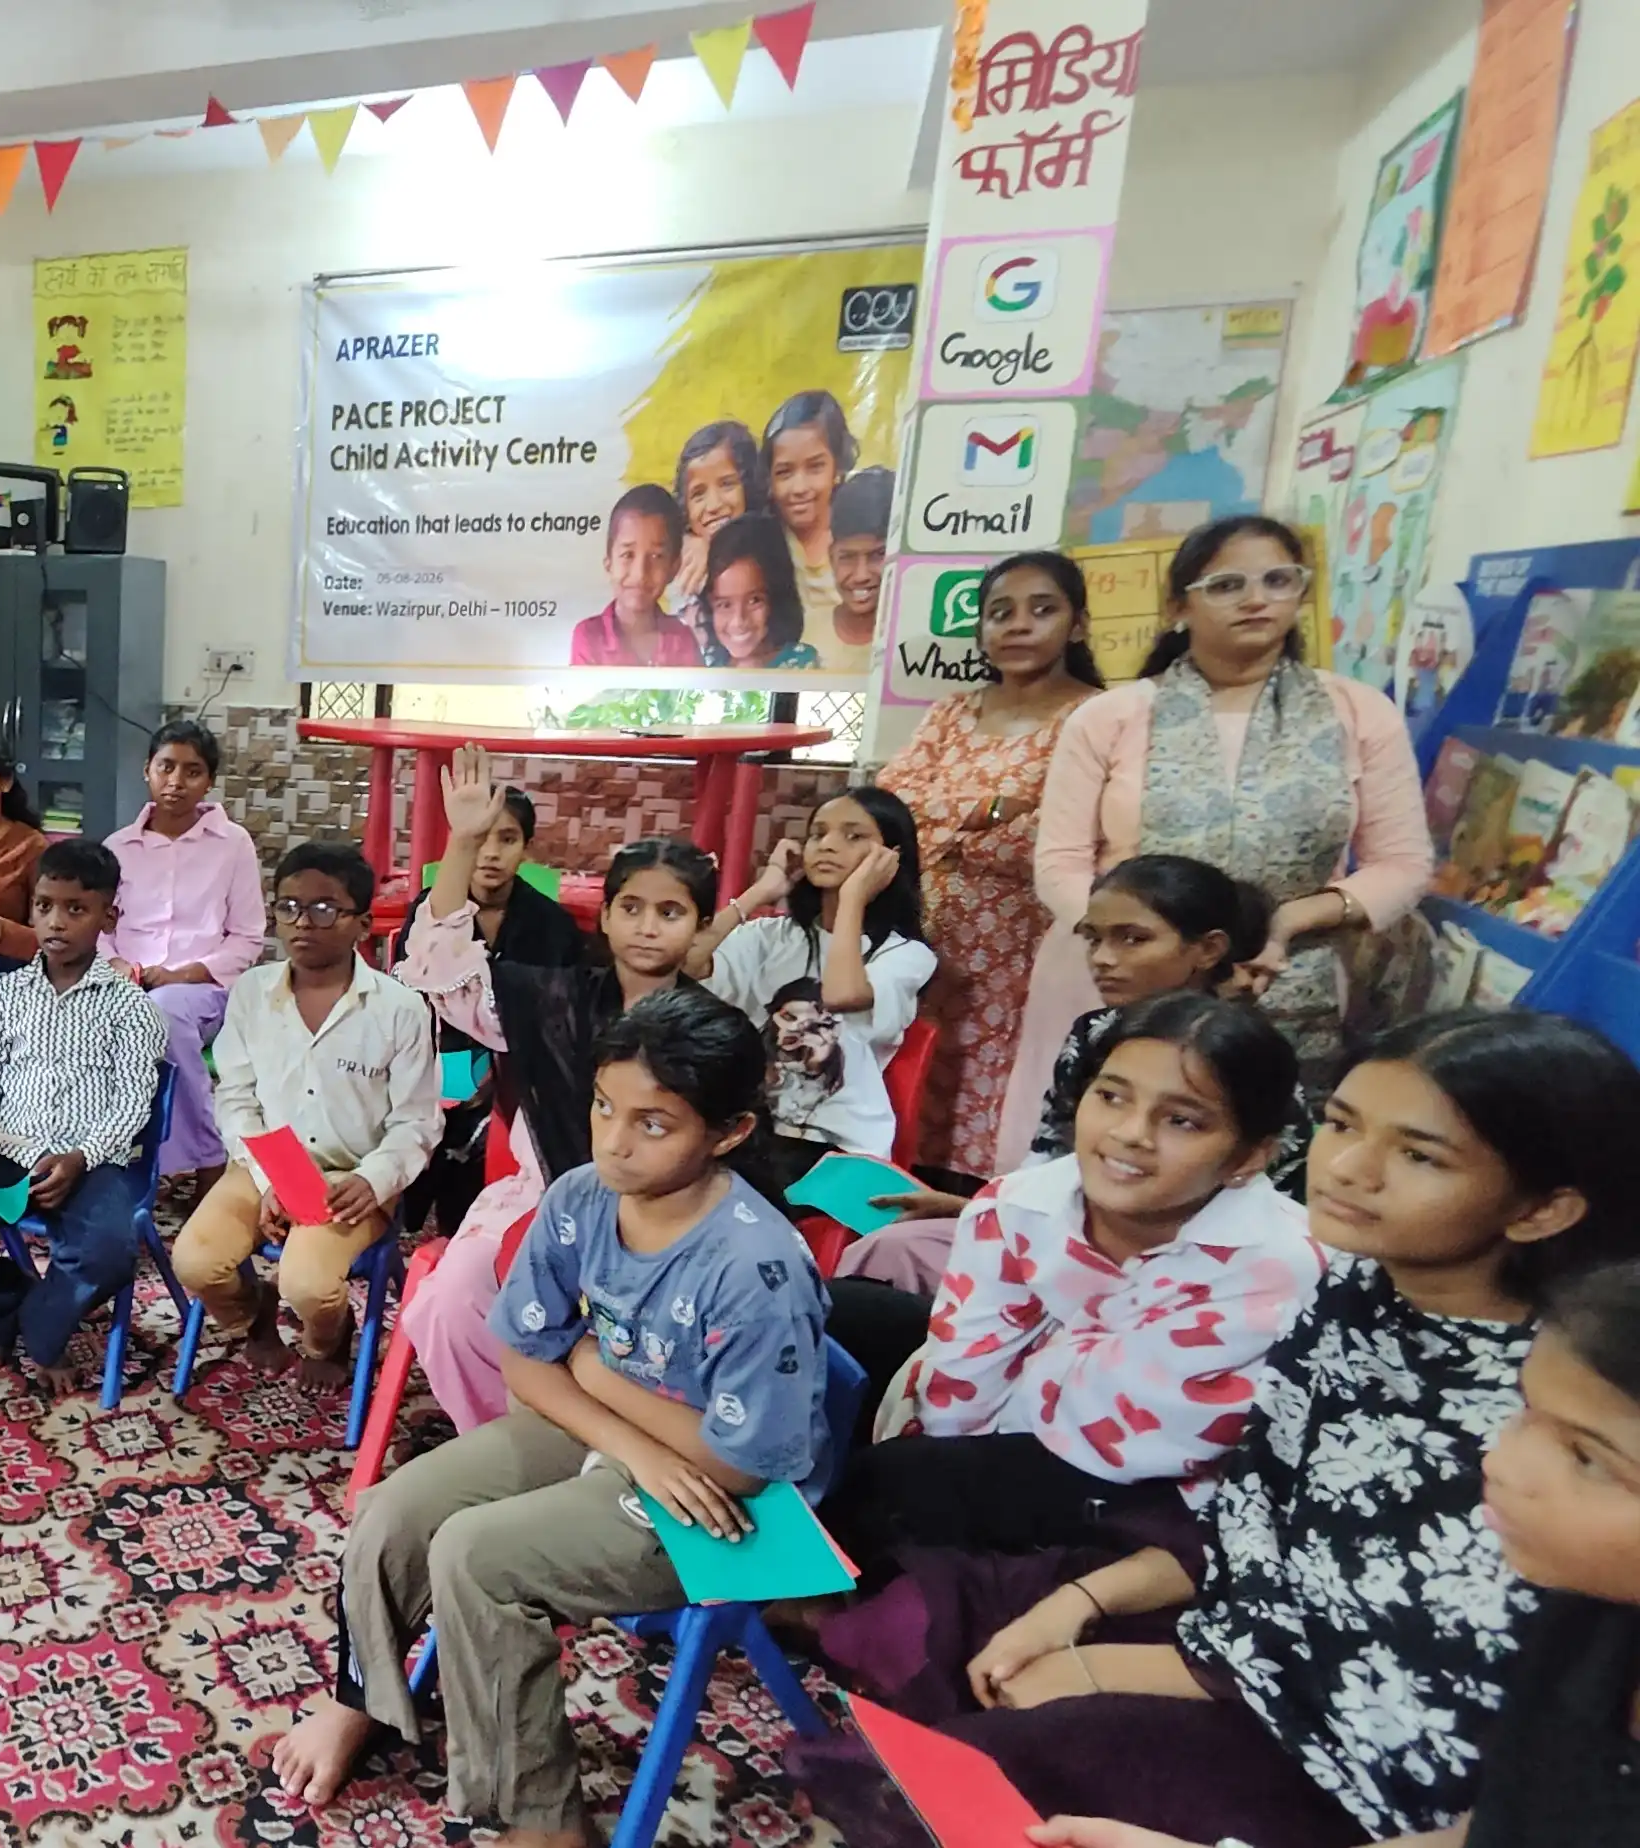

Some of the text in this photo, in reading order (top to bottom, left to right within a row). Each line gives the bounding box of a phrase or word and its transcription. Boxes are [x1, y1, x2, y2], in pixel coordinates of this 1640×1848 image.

[336, 333, 439, 362] APRAZER
[940, 330, 1054, 386] Google
[331, 395, 506, 431] PACE PROJECT
[330, 436, 598, 473] Child Activity Centre
[327, 511, 602, 536] Education that leads to change
[923, 493, 1033, 536] Gmail
[324, 575, 363, 590] Date:
[323, 601, 373, 616] Venue:
[376, 600, 445, 620] Wazirpur,
[448, 600, 488, 617] Delhi
[504, 600, 558, 617] 110052
[898, 642, 993, 683] Whats
